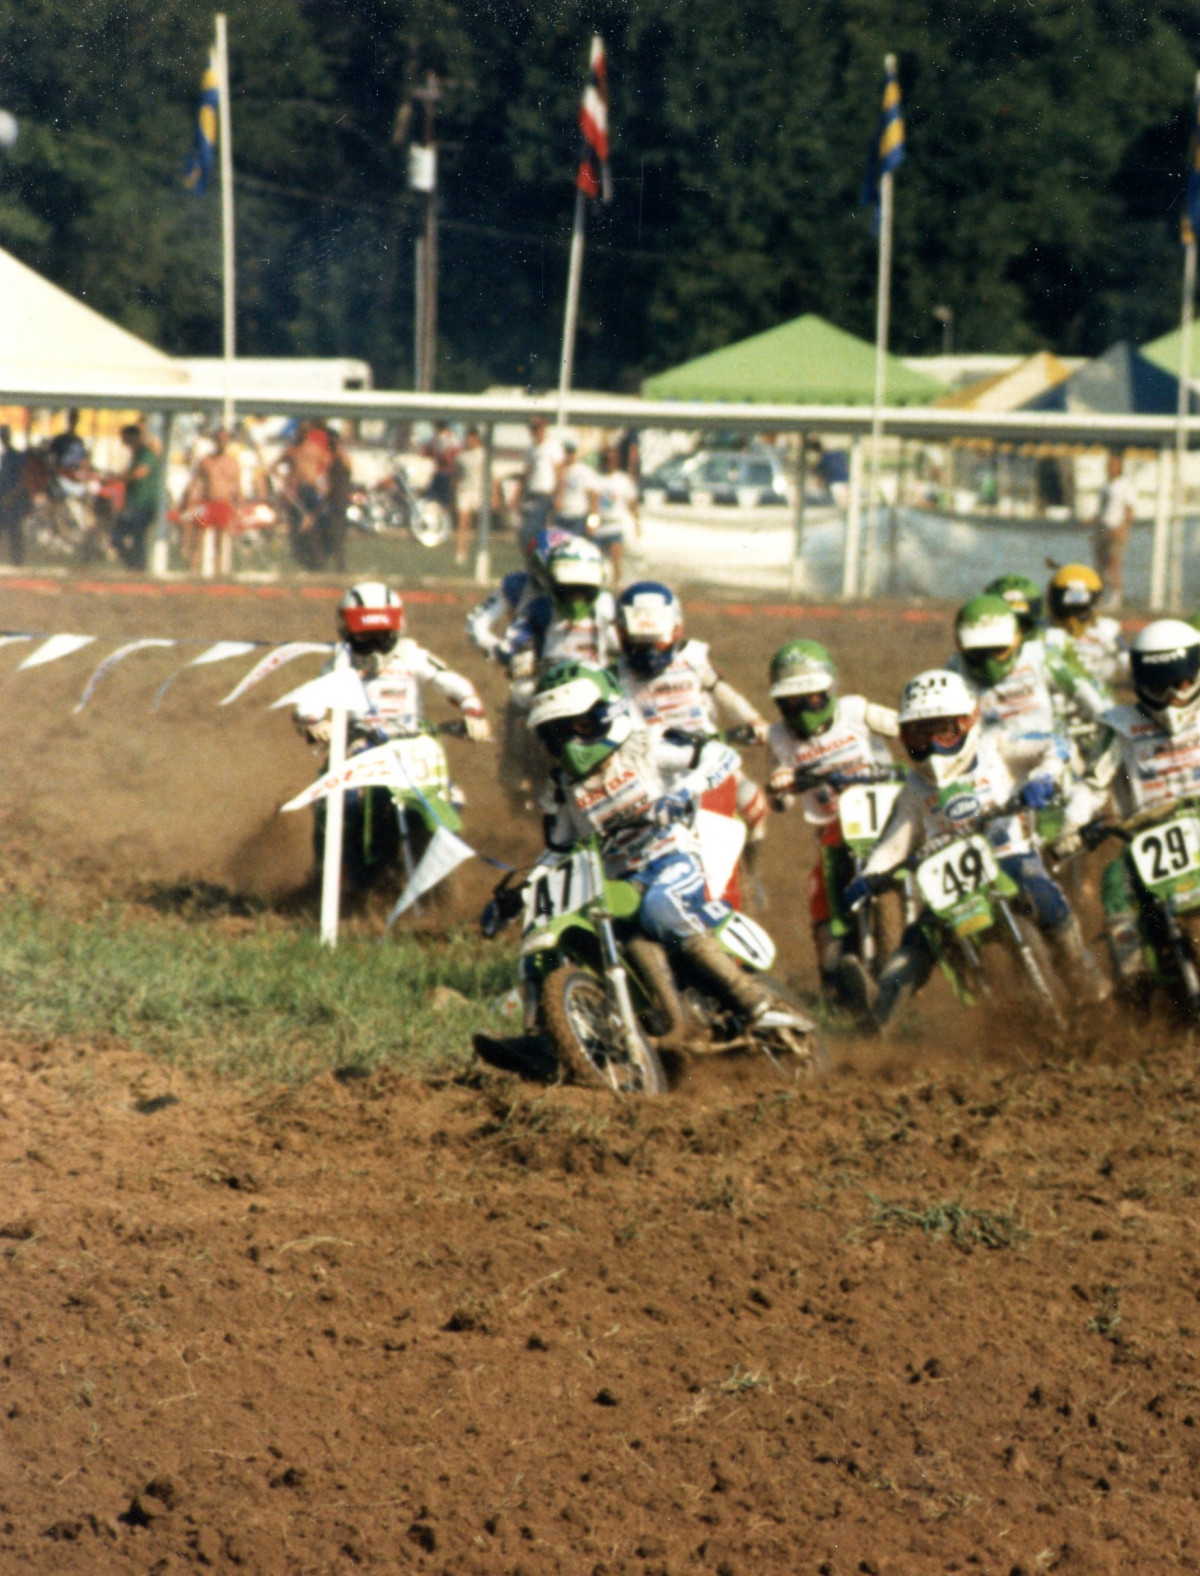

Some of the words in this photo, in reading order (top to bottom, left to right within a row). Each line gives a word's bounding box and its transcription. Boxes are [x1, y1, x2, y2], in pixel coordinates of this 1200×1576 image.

[865, 791, 878, 832] 1
[942, 847, 983, 896] 49
[1142, 825, 1190, 880] 29
